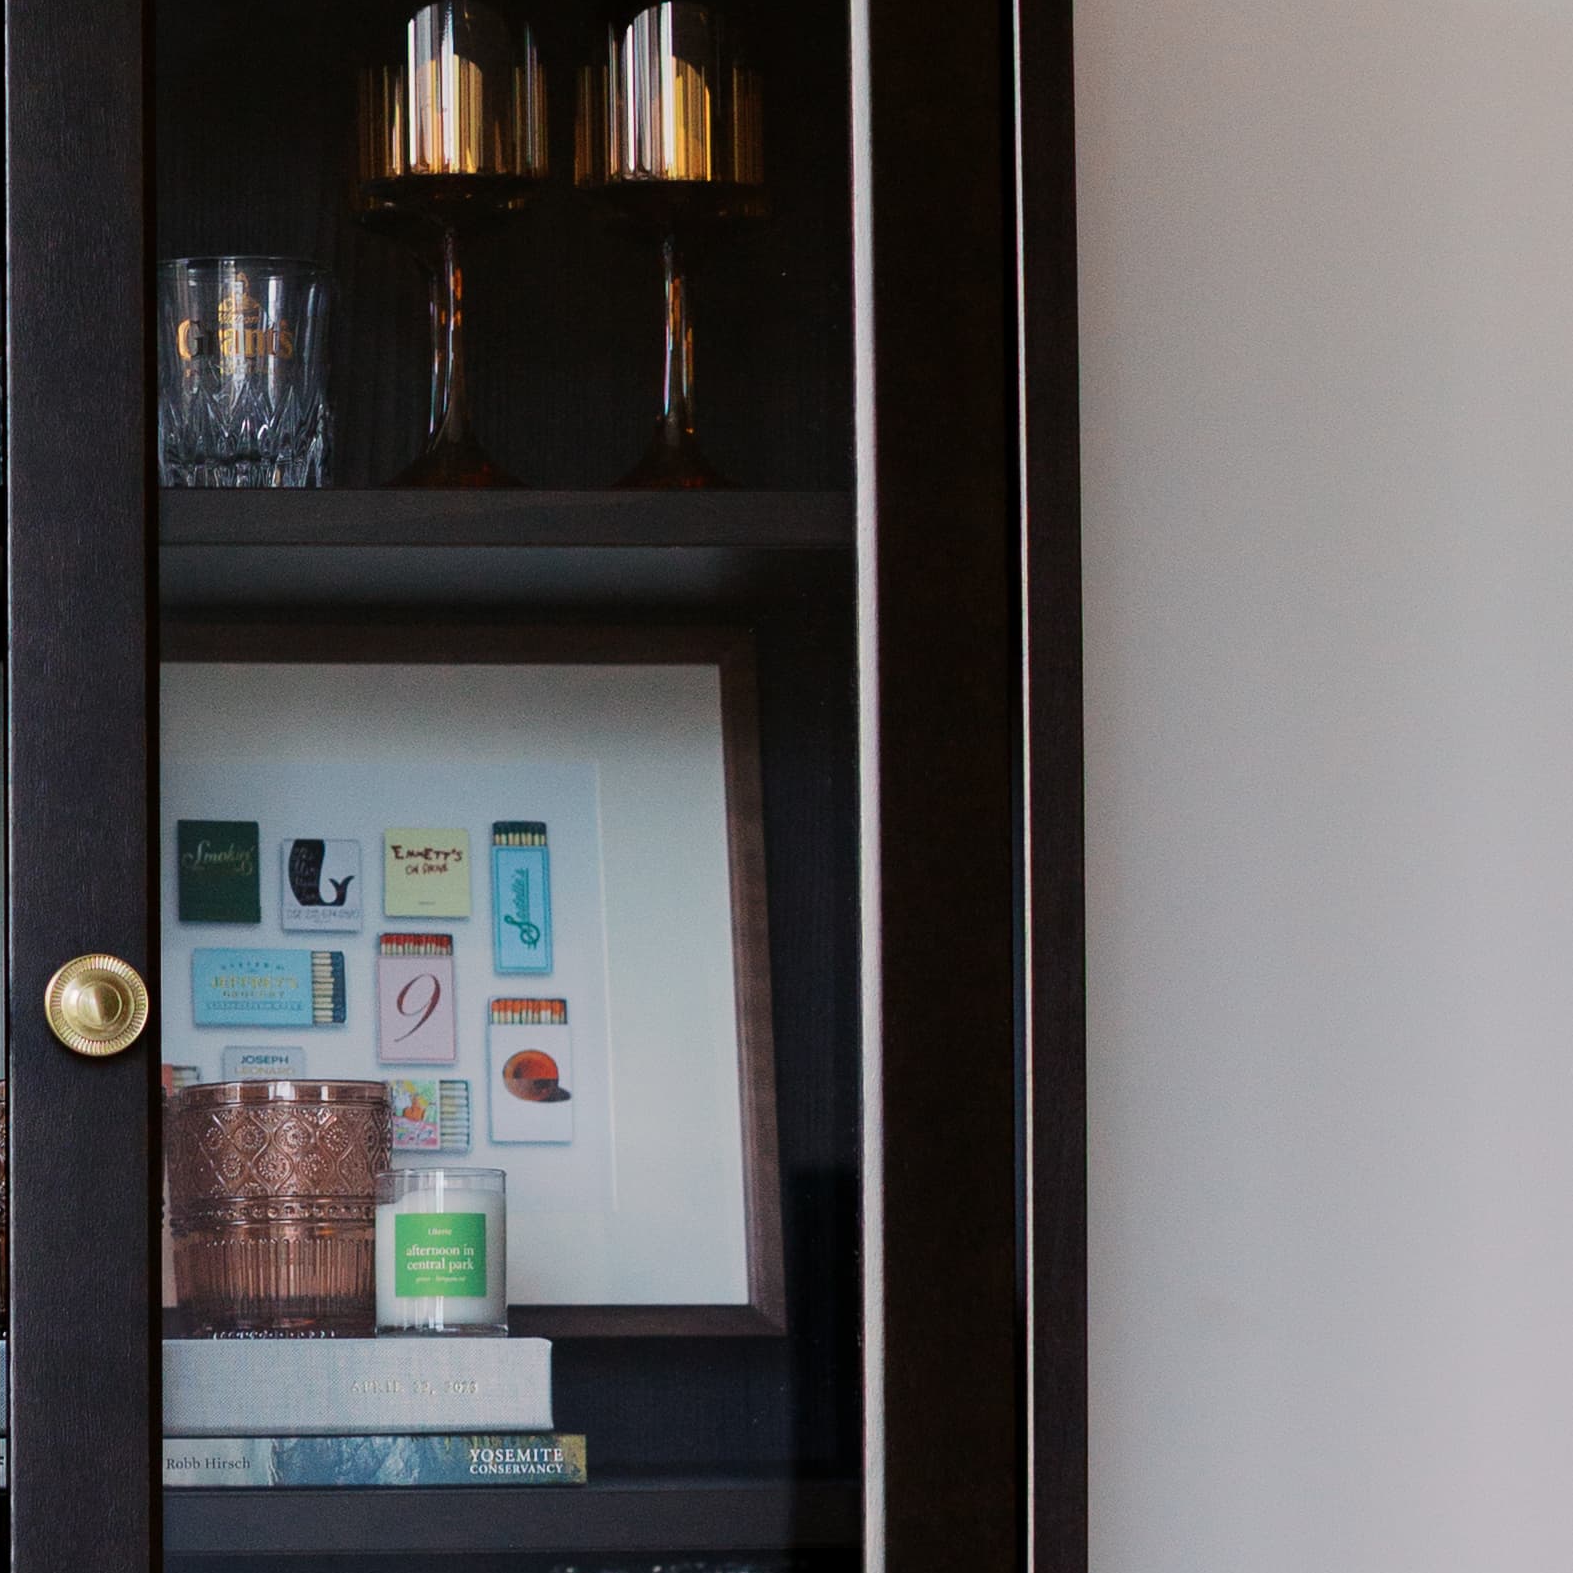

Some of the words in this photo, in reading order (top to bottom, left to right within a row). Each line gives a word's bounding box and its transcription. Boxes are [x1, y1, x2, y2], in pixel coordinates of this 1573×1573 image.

[393, 973, 441, 1043] 9
[240, 1054, 290, 1065] JOSEPH
[234, 1065, 296, 1075] LEONARD
[405, 1243, 461, 1256] afternoon
[463, 1243, 474, 1256] in
[406, 1257, 446, 1270] central
[449, 1257, 475, 1273] park
[350, 1379, 400, 1394] APRIL
[469, 1447, 564, 1463] YOSEMITE
[166, 1457, 200, 1470] Robb
[205, 1457, 251, 1470] Hirsch
[469, 1462, 564, 1474] CONSERVANCY
